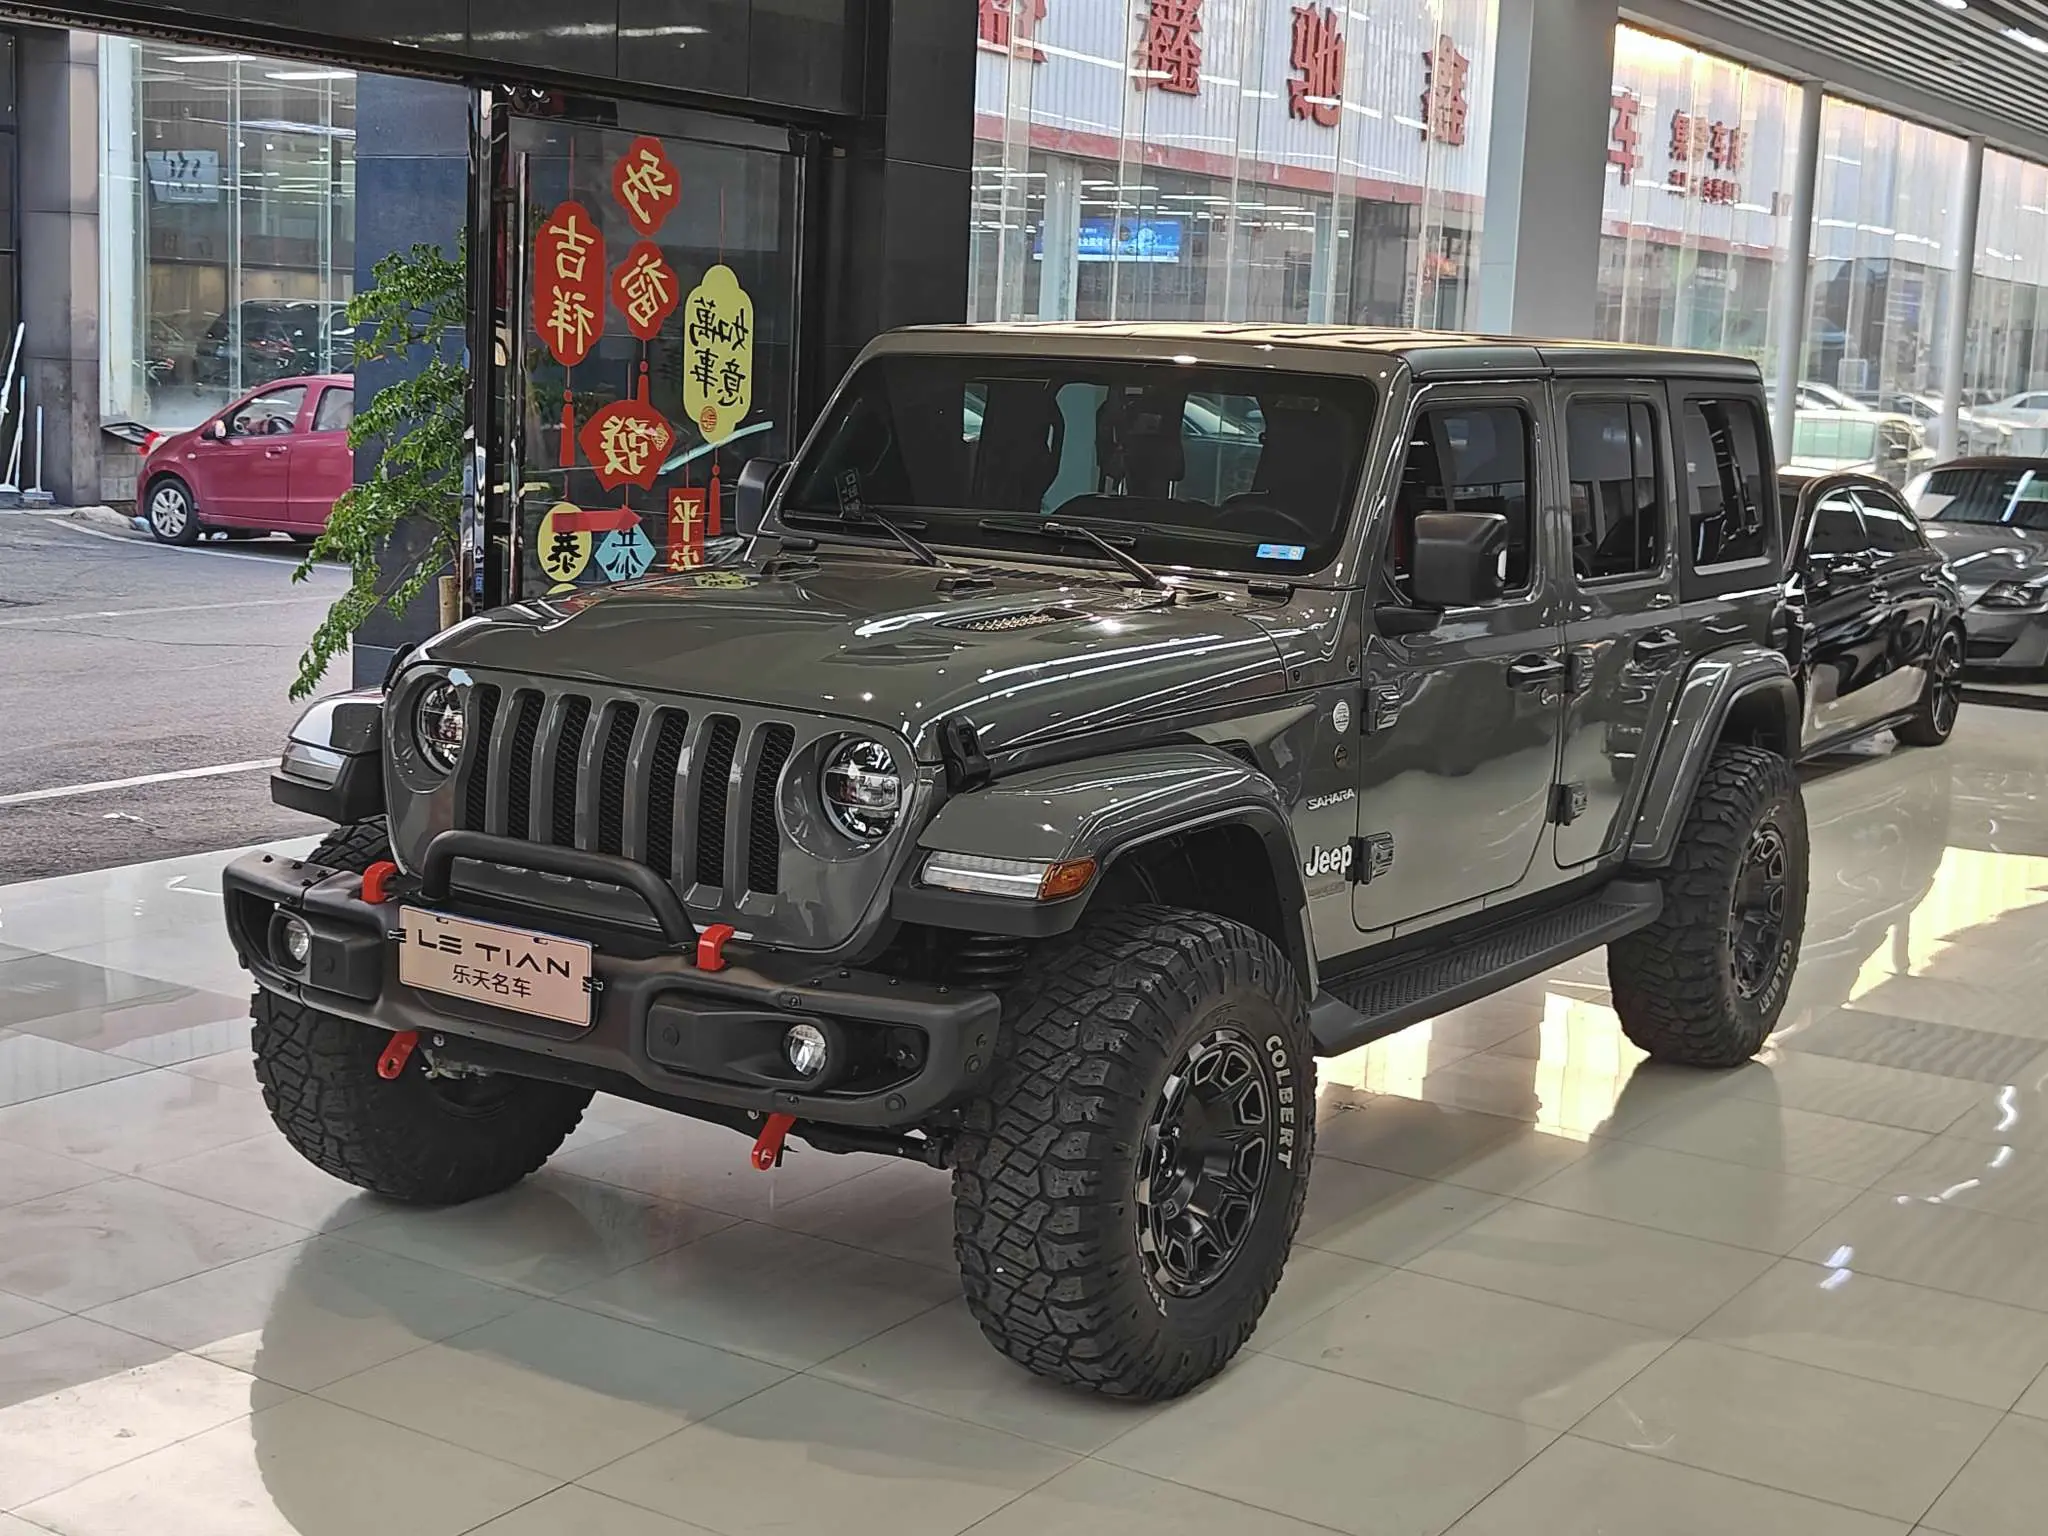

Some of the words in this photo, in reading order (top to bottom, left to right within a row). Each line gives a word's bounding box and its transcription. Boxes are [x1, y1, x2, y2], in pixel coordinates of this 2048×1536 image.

[1307, 788, 1355, 811] SAHARA
[1306, 844, 1352, 877] Jeep
[418, 929, 463, 955] LE
[475, 942, 570, 978] TIAN
[452, 964, 532, 998] 乐天名车
[1265, 1034, 1297, 1170] COLBERT
